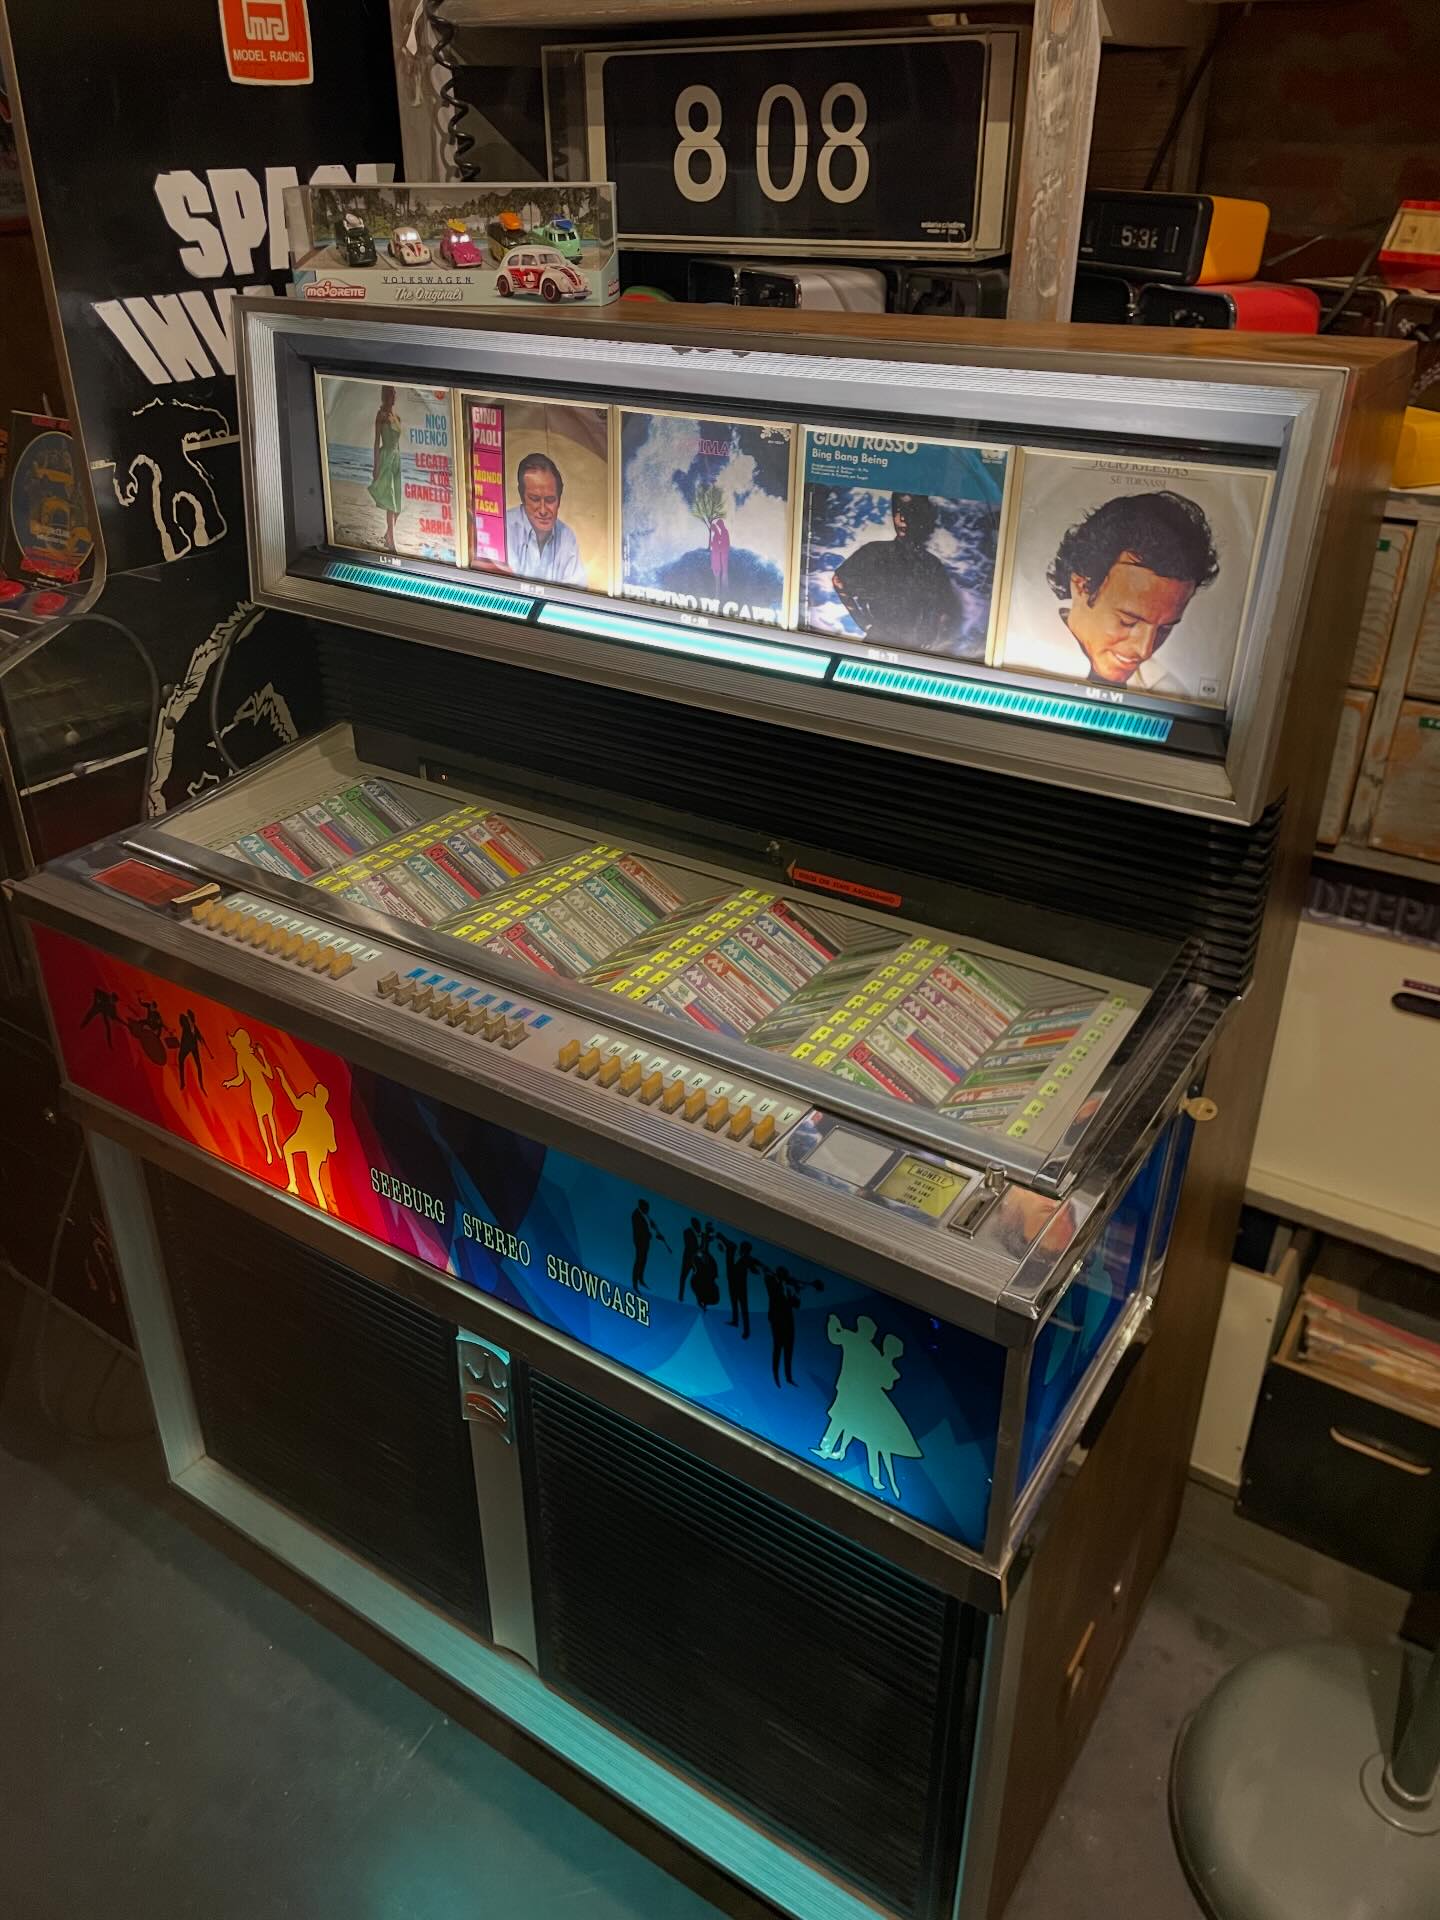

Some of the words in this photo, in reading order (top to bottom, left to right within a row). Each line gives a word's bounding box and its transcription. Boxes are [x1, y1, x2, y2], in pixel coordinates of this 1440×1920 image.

[233, 48, 267, 62] MODEL
[269, 50, 305, 63] RACING
[674, 84, 727, 202] 8
[756, 82, 870, 204] 08
[383, 276, 473, 284] VOLKSWAGEN
[395, 287, 414, 301] The
[416, 287, 463, 303] Originals
[425, 414, 447, 430] NICO
[472, 407, 496, 425] GINO
[410, 428, 448, 447] FIDENCO
[474, 428, 501, 447] PAOLI
[862, 437, 924, 454] RUSSO
[812, 448, 832, 461] Bing
[834, 450, 858, 464] Bang
[861, 453, 888, 468] Being
[419, 518, 454, 536] SABBIA
[692, 1077, 703, 1086] R
[715, 1086, 725, 1095] S
[760, 1103, 770, 1112] U
[783, 1112, 793, 1121] V
[370, 1167, 446, 1225] SEEBURG
[463, 1212, 531, 1267] STEREO
[547, 1254, 650, 1327] SHOWCASE
